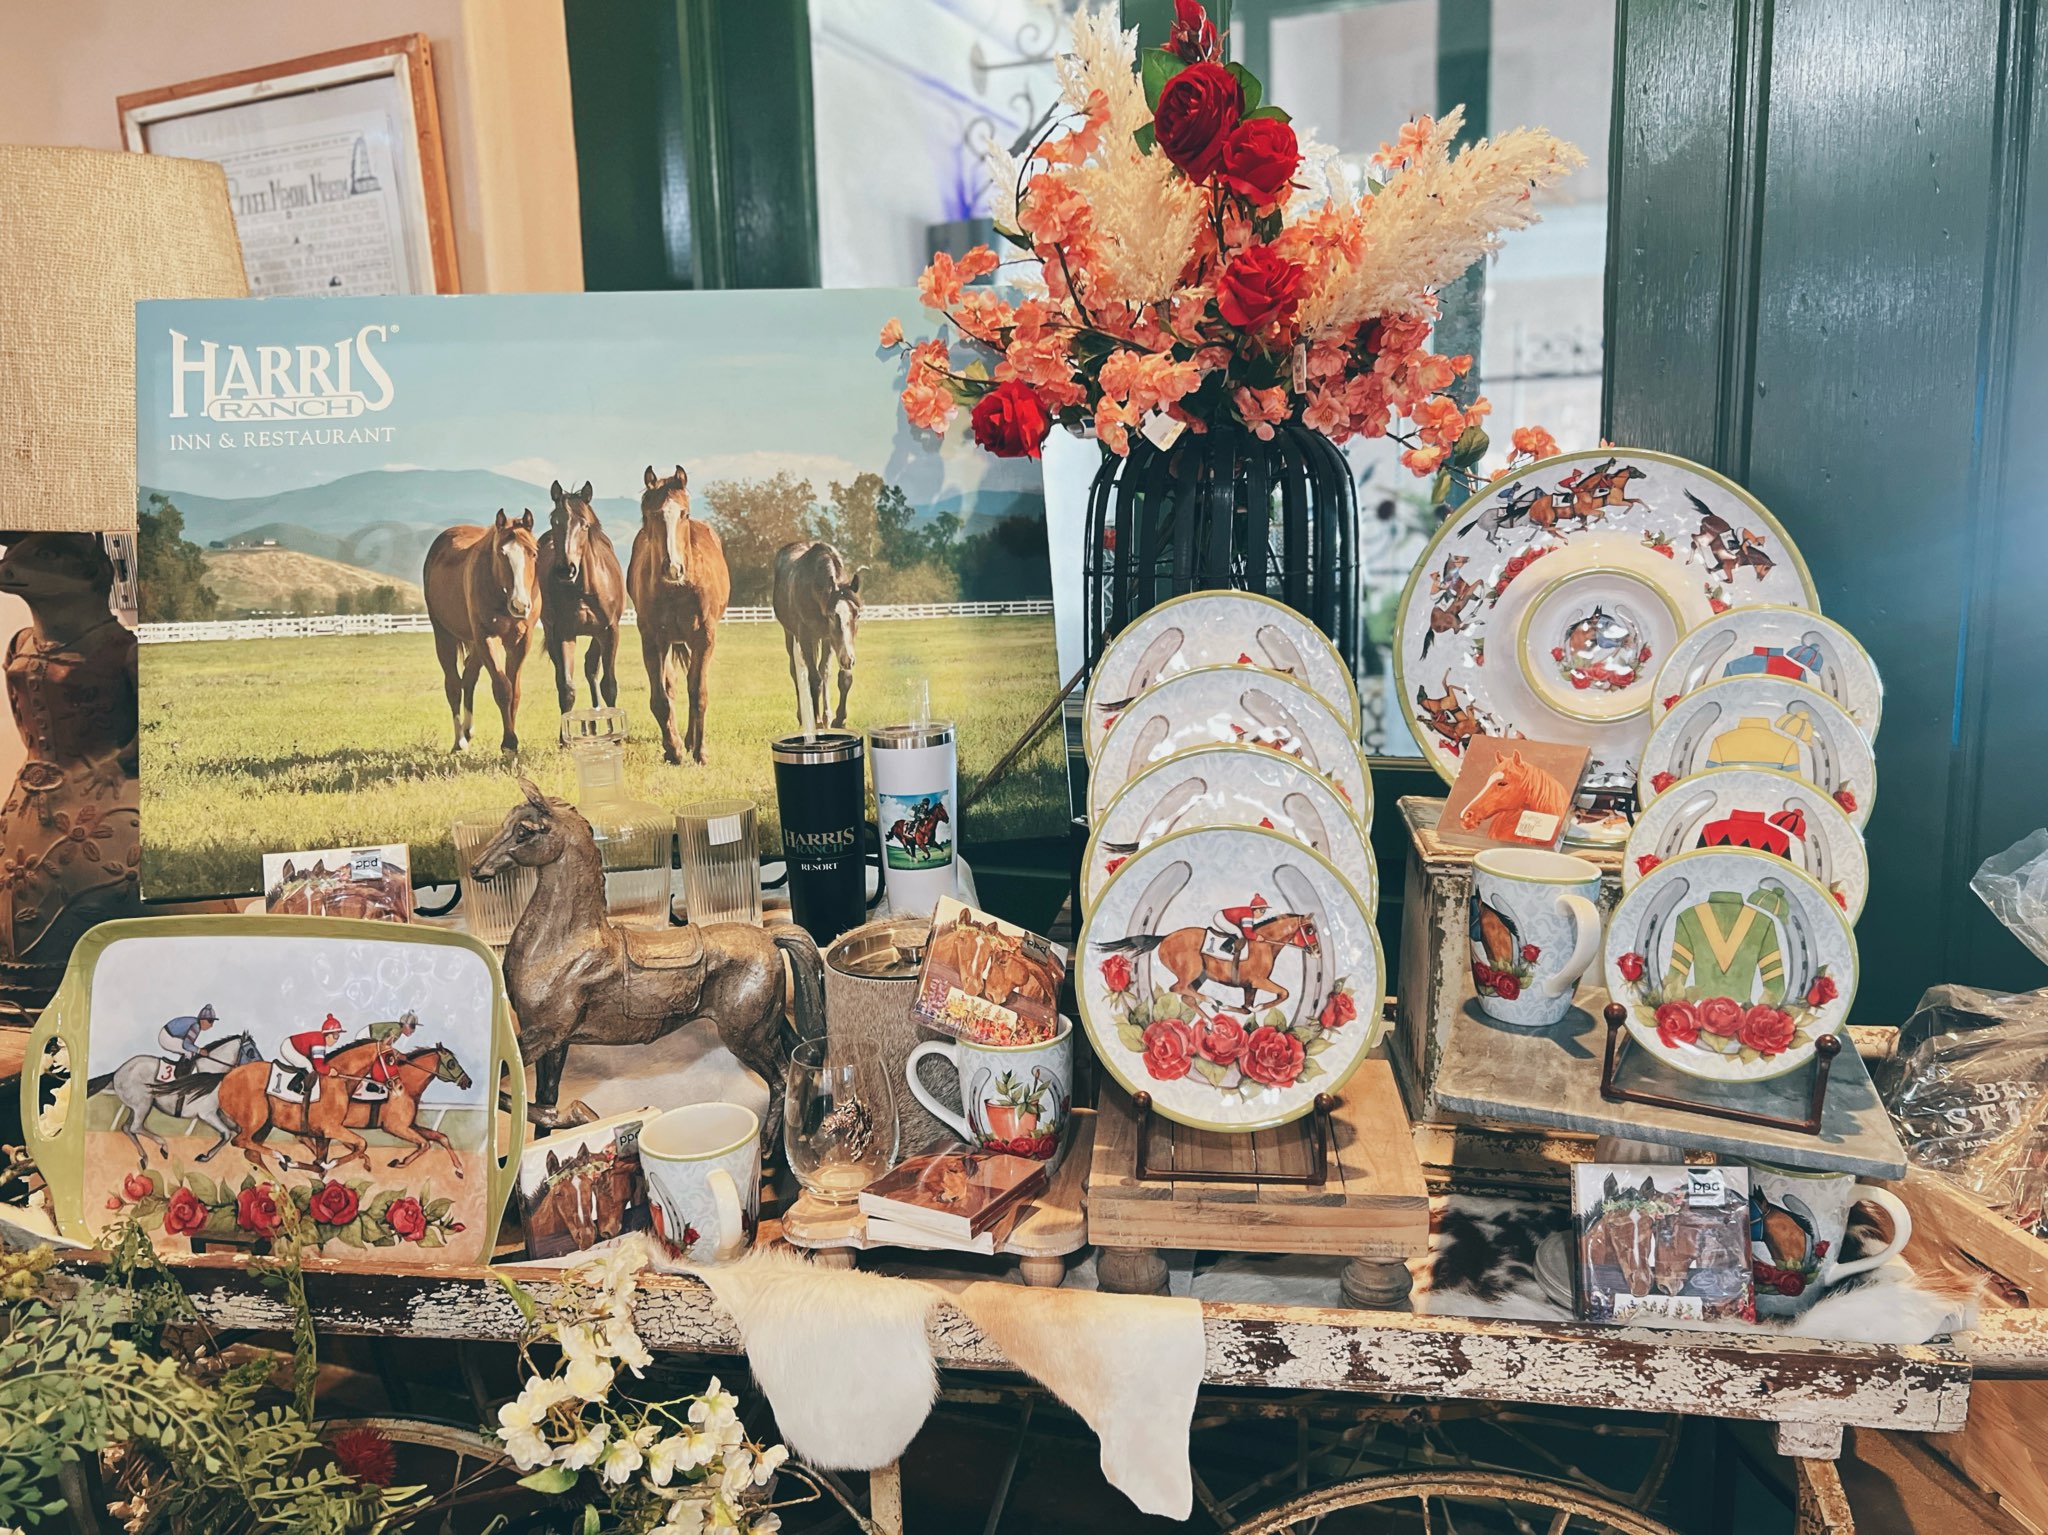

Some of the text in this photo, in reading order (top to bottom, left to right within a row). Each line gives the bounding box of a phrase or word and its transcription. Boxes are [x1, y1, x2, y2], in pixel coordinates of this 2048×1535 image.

[219, 399, 354, 418] RANCH
[170, 427, 395, 451] INN & RESTAURANT
[784, 826, 855, 848] HARRIS
[796, 843, 843, 855] RANCH
[801, 862, 838, 871] RESORT
[1026, 940, 1048, 955] ppd
[1207, 937, 1216, 953] 1
[161, 1065, 173, 1081] 3
[274, 1073, 283, 1094] 1
